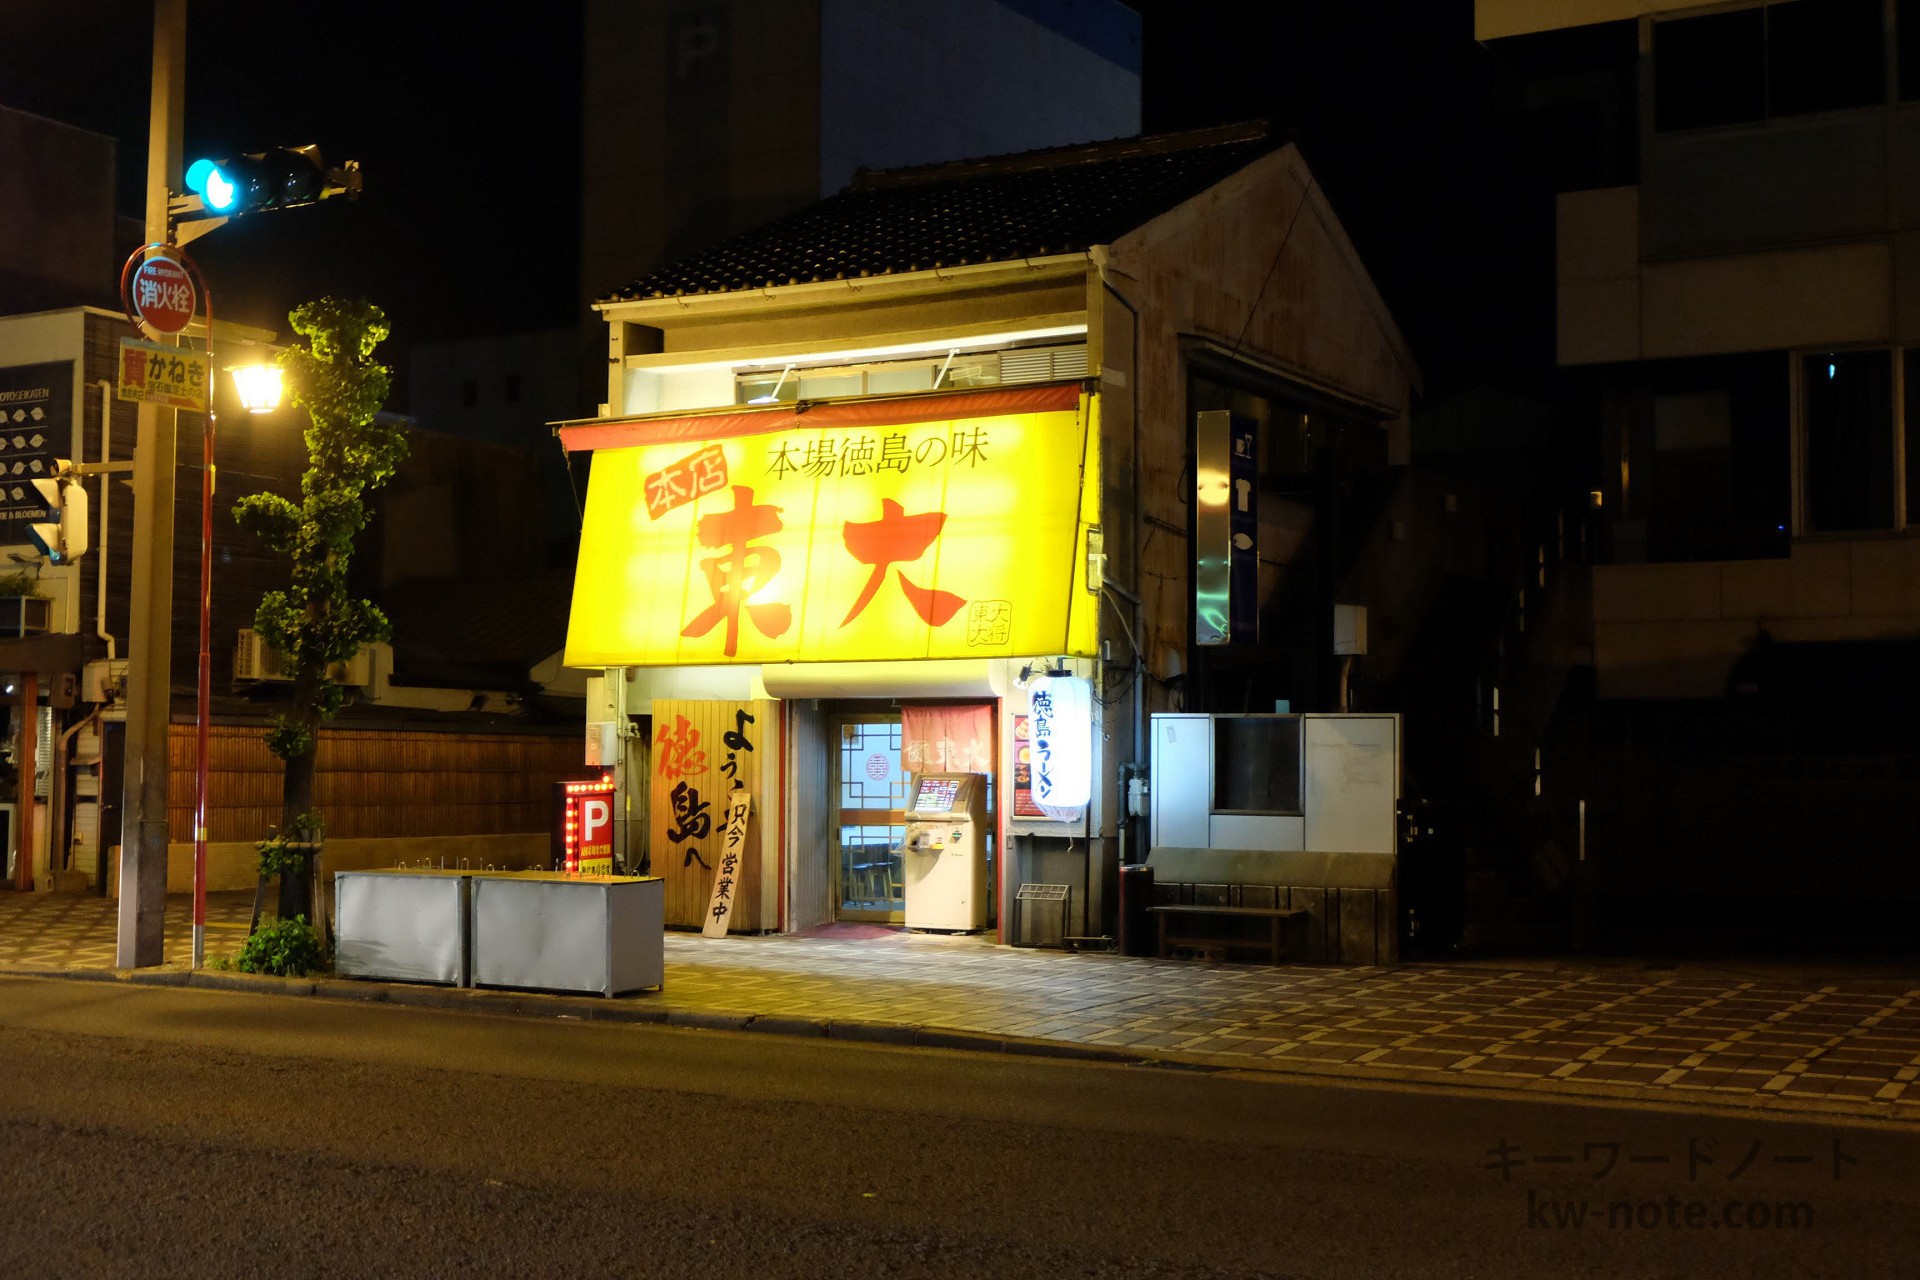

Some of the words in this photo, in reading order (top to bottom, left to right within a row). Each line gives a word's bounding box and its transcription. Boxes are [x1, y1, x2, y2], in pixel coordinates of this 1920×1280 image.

[140, 278, 190, 313] 消火栓
[123, 348, 148, 388] 質
[149, 352, 204, 387] かねき
[764, 425, 990, 480] 本場徳島の味
[648, 453, 727, 510] 本店
[680, 484, 968, 658] 東大
[1031, 690, 1054, 800] 徳島ラーメン
[584, 800, 609, 842] P
[712, 801, 748, 925] 只今営業中
